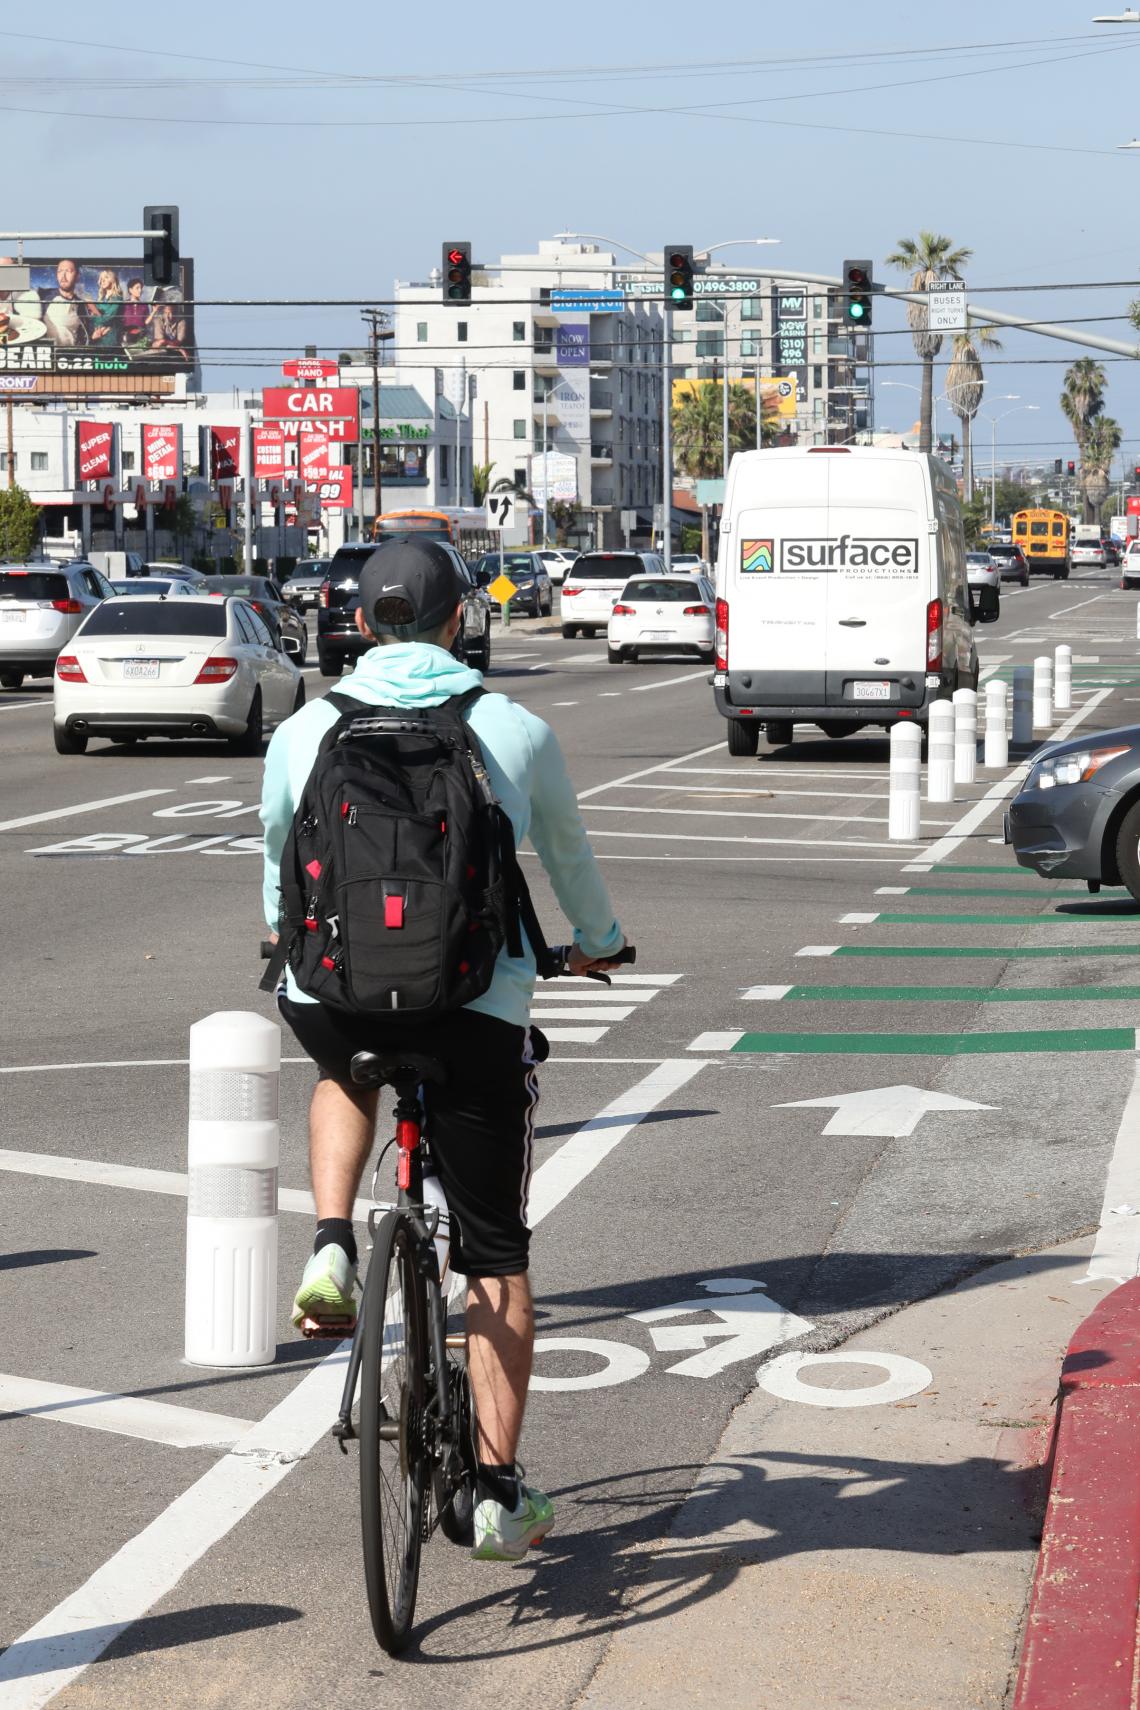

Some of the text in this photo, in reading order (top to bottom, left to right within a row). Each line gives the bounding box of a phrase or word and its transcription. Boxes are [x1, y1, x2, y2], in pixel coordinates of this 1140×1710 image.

[625, 282, 665, 292] LEASIN
[930, 282, 964, 290] RIGHT LANE
[781, 297, 802, 308] MV
[561, 334, 584, 343] NOW
[780, 339, 804, 349] (310)
[560, 348, 585, 357] OPEN
[782, 349, 802, 358] 496
[57, 357, 128, 370] 6.22 hulu
[297, 369, 323, 377] HAND
[560, 391, 585, 401] IRON
[287, 393, 333, 412] CAR
[279, 420, 344, 436] WASH
[80, 432, 110, 452] SUPER
[147, 437, 166, 454] MINI
[215, 438, 237, 450] CLAY
[148, 444, 174, 463] DETAIL
[256, 454, 282, 464] POLISH
[81, 453, 108, 473] CLEAN
[787, 535, 911, 566] surface
